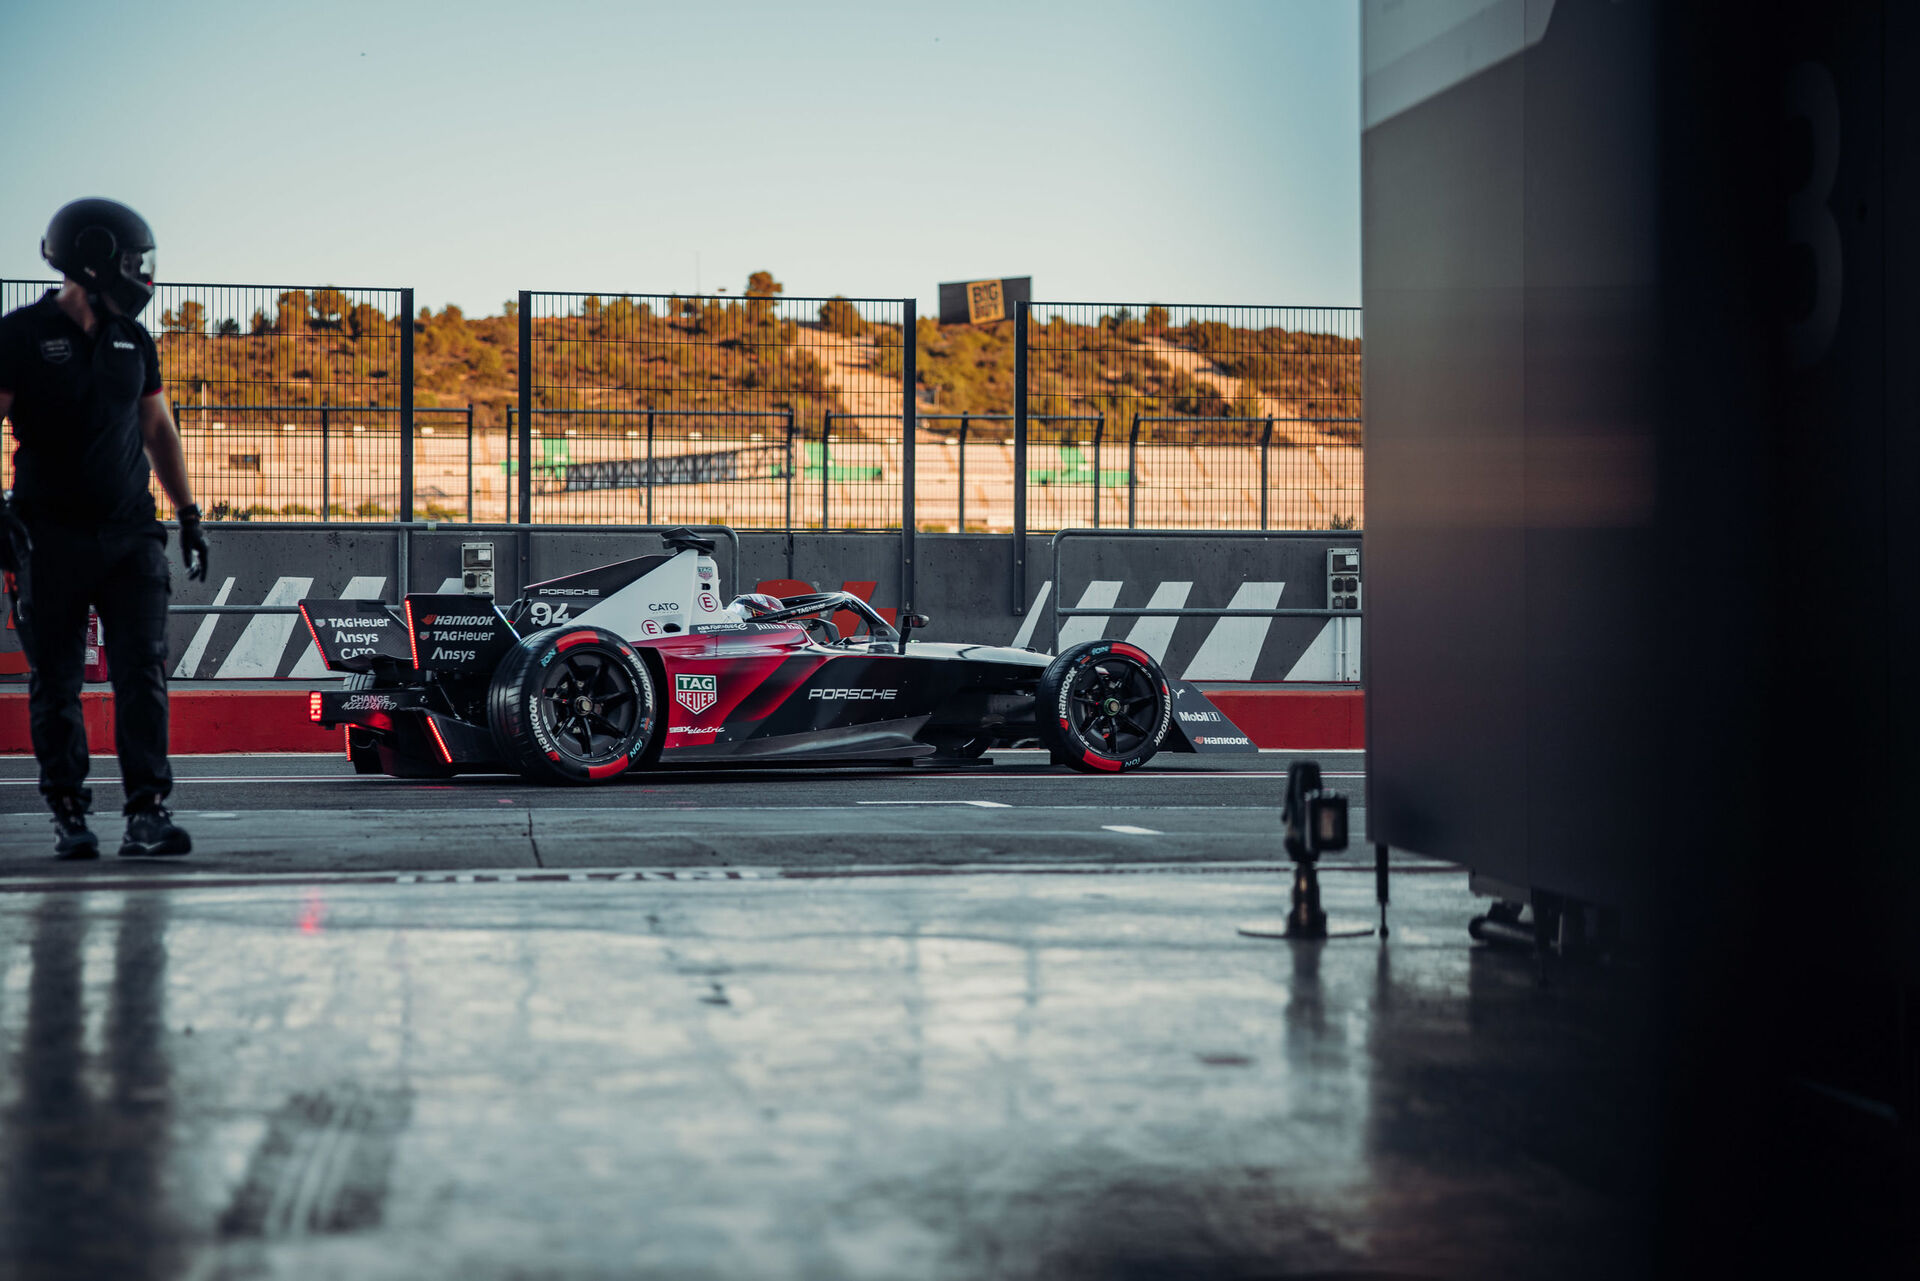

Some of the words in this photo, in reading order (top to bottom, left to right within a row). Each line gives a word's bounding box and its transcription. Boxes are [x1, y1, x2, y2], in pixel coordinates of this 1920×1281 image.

[539, 588, 600, 596] PORSCHE
[648, 602, 680, 612] CATO
[530, 602, 573, 627] 94
[334, 630, 380, 646] Ansys
[430, 646, 476, 663] Ansys
[678, 677, 713, 690] TAG
[350, 694, 391, 703] CHANGE
[808, 688, 898, 700] PORSCHE
[341, 700, 398, 711] ACCELERATED
[678, 692, 714, 711] HEUER
[1178, 711, 1209, 722] Mobil
